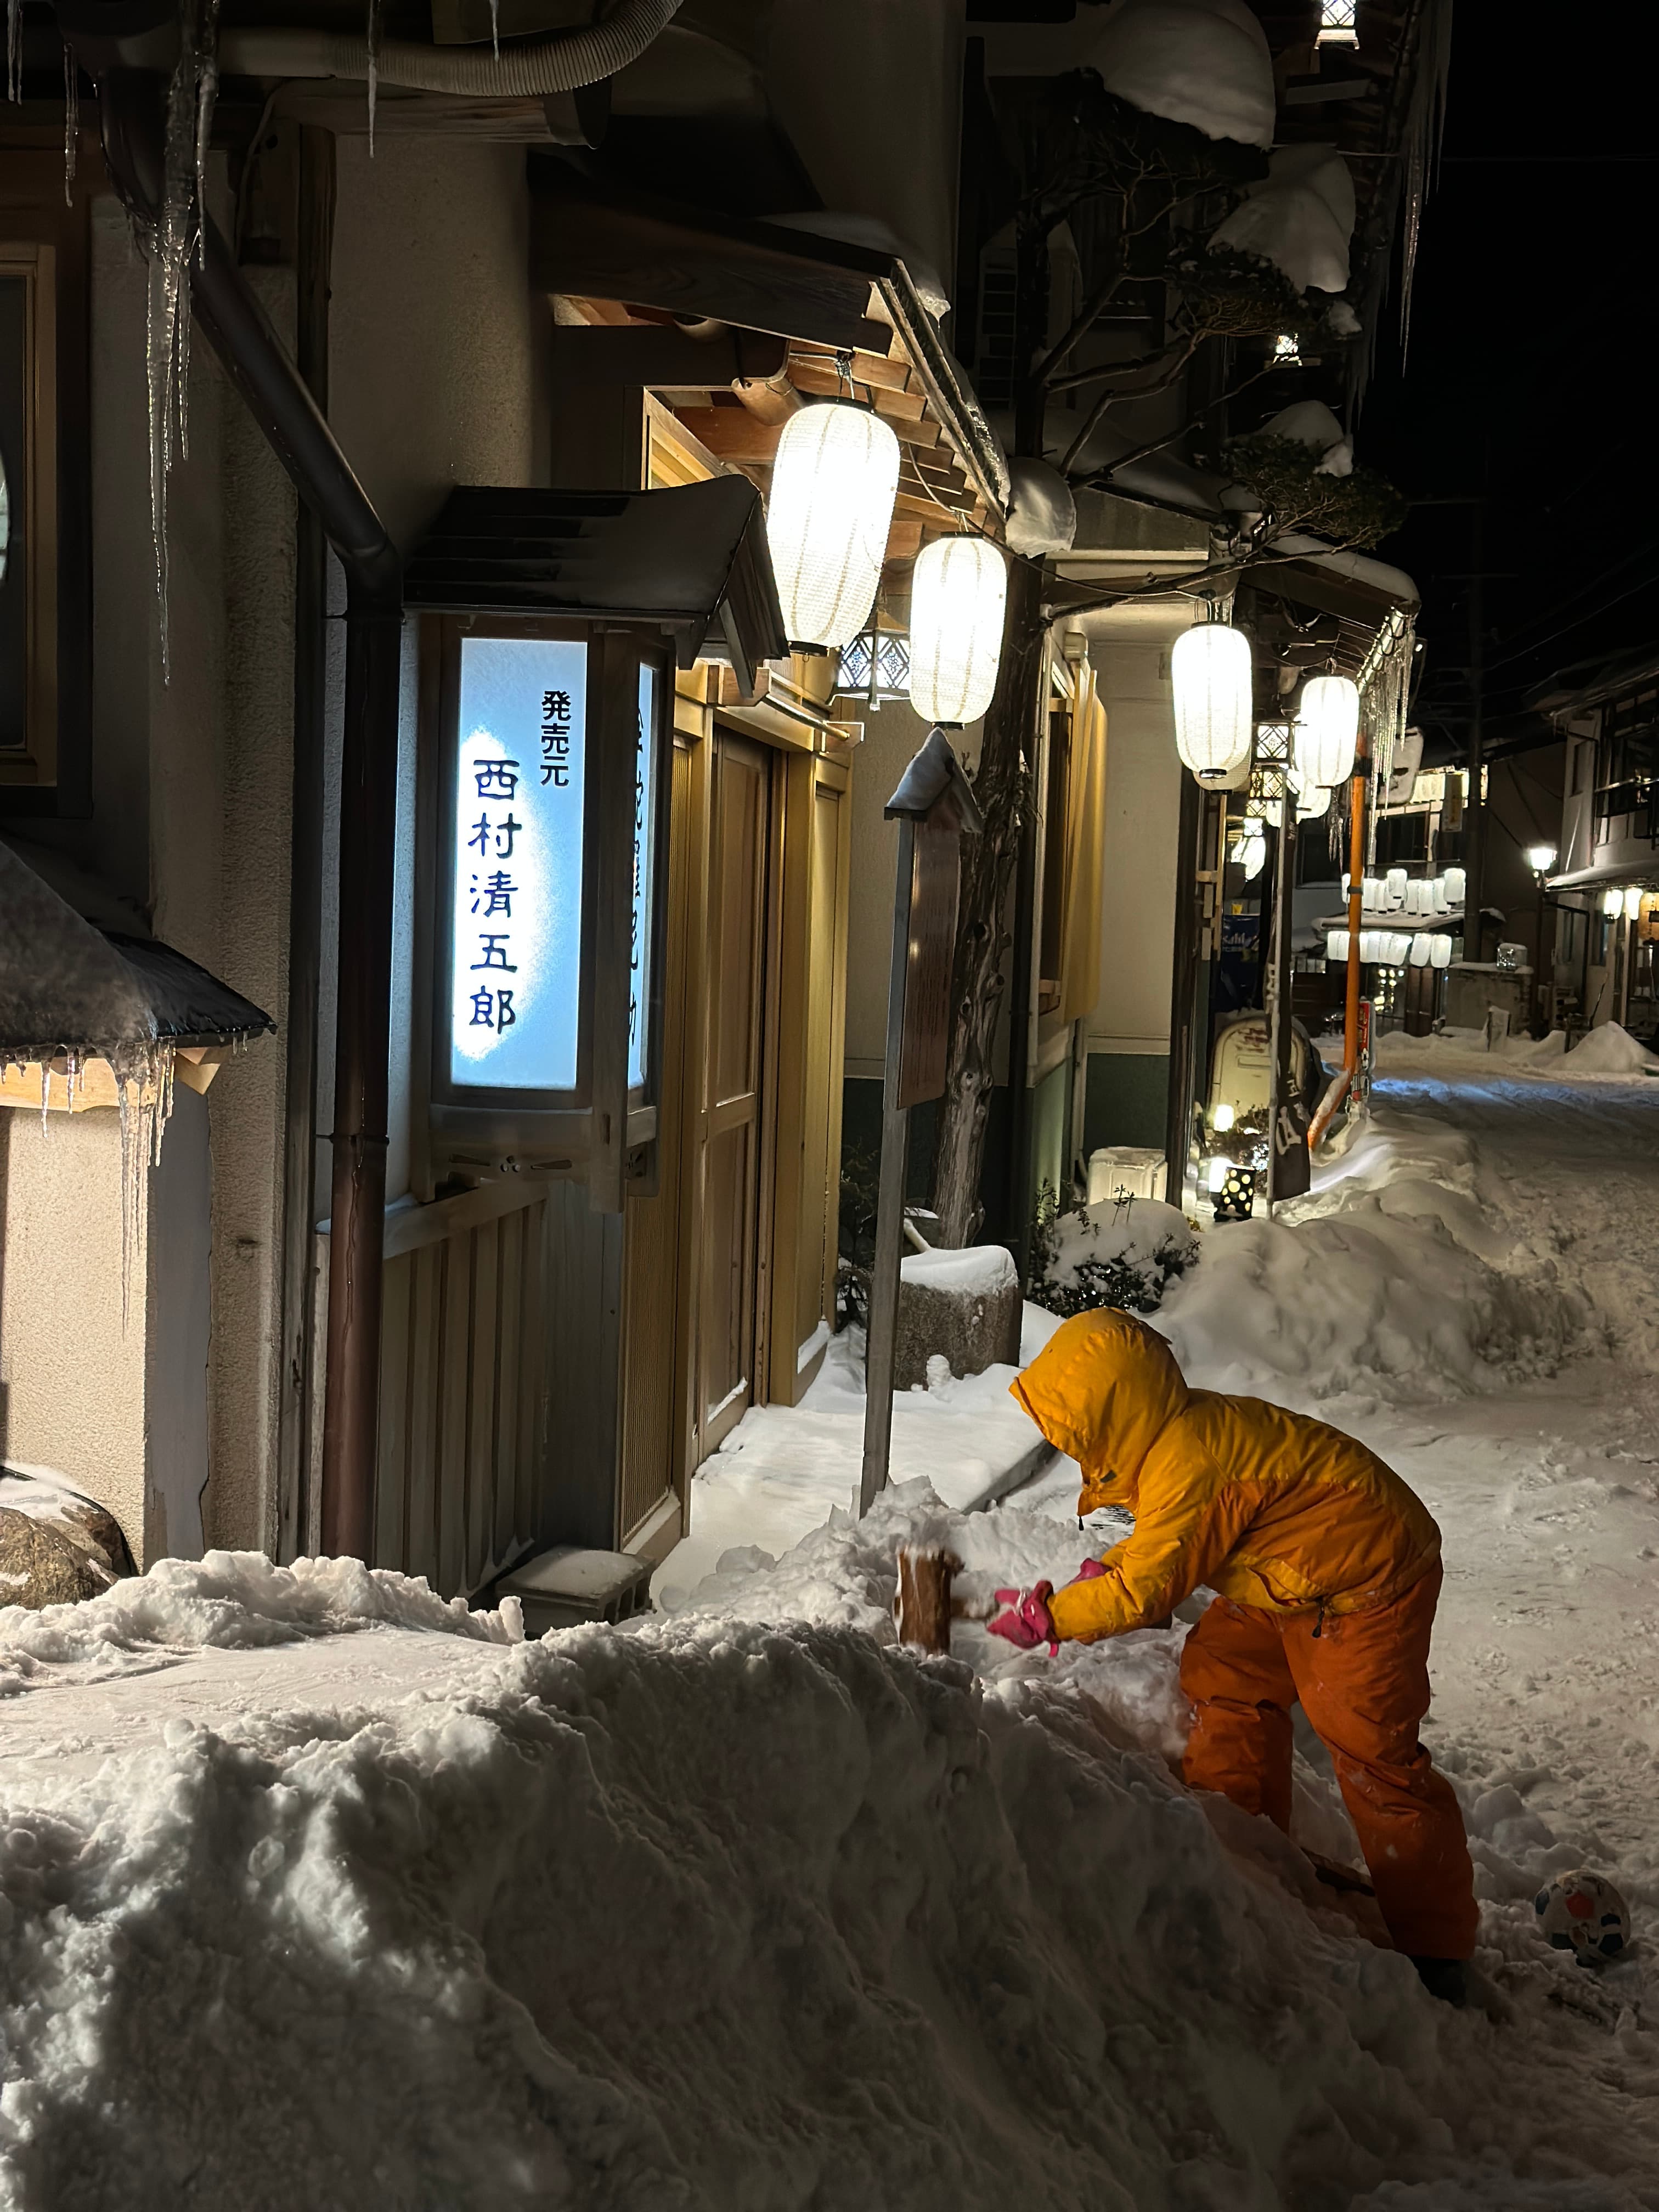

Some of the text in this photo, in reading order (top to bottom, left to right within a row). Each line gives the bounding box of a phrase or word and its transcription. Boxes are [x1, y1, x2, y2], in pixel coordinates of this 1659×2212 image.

[540, 690, 572, 787] 発売元
[467, 759, 522, 1034] 西村清五郎
